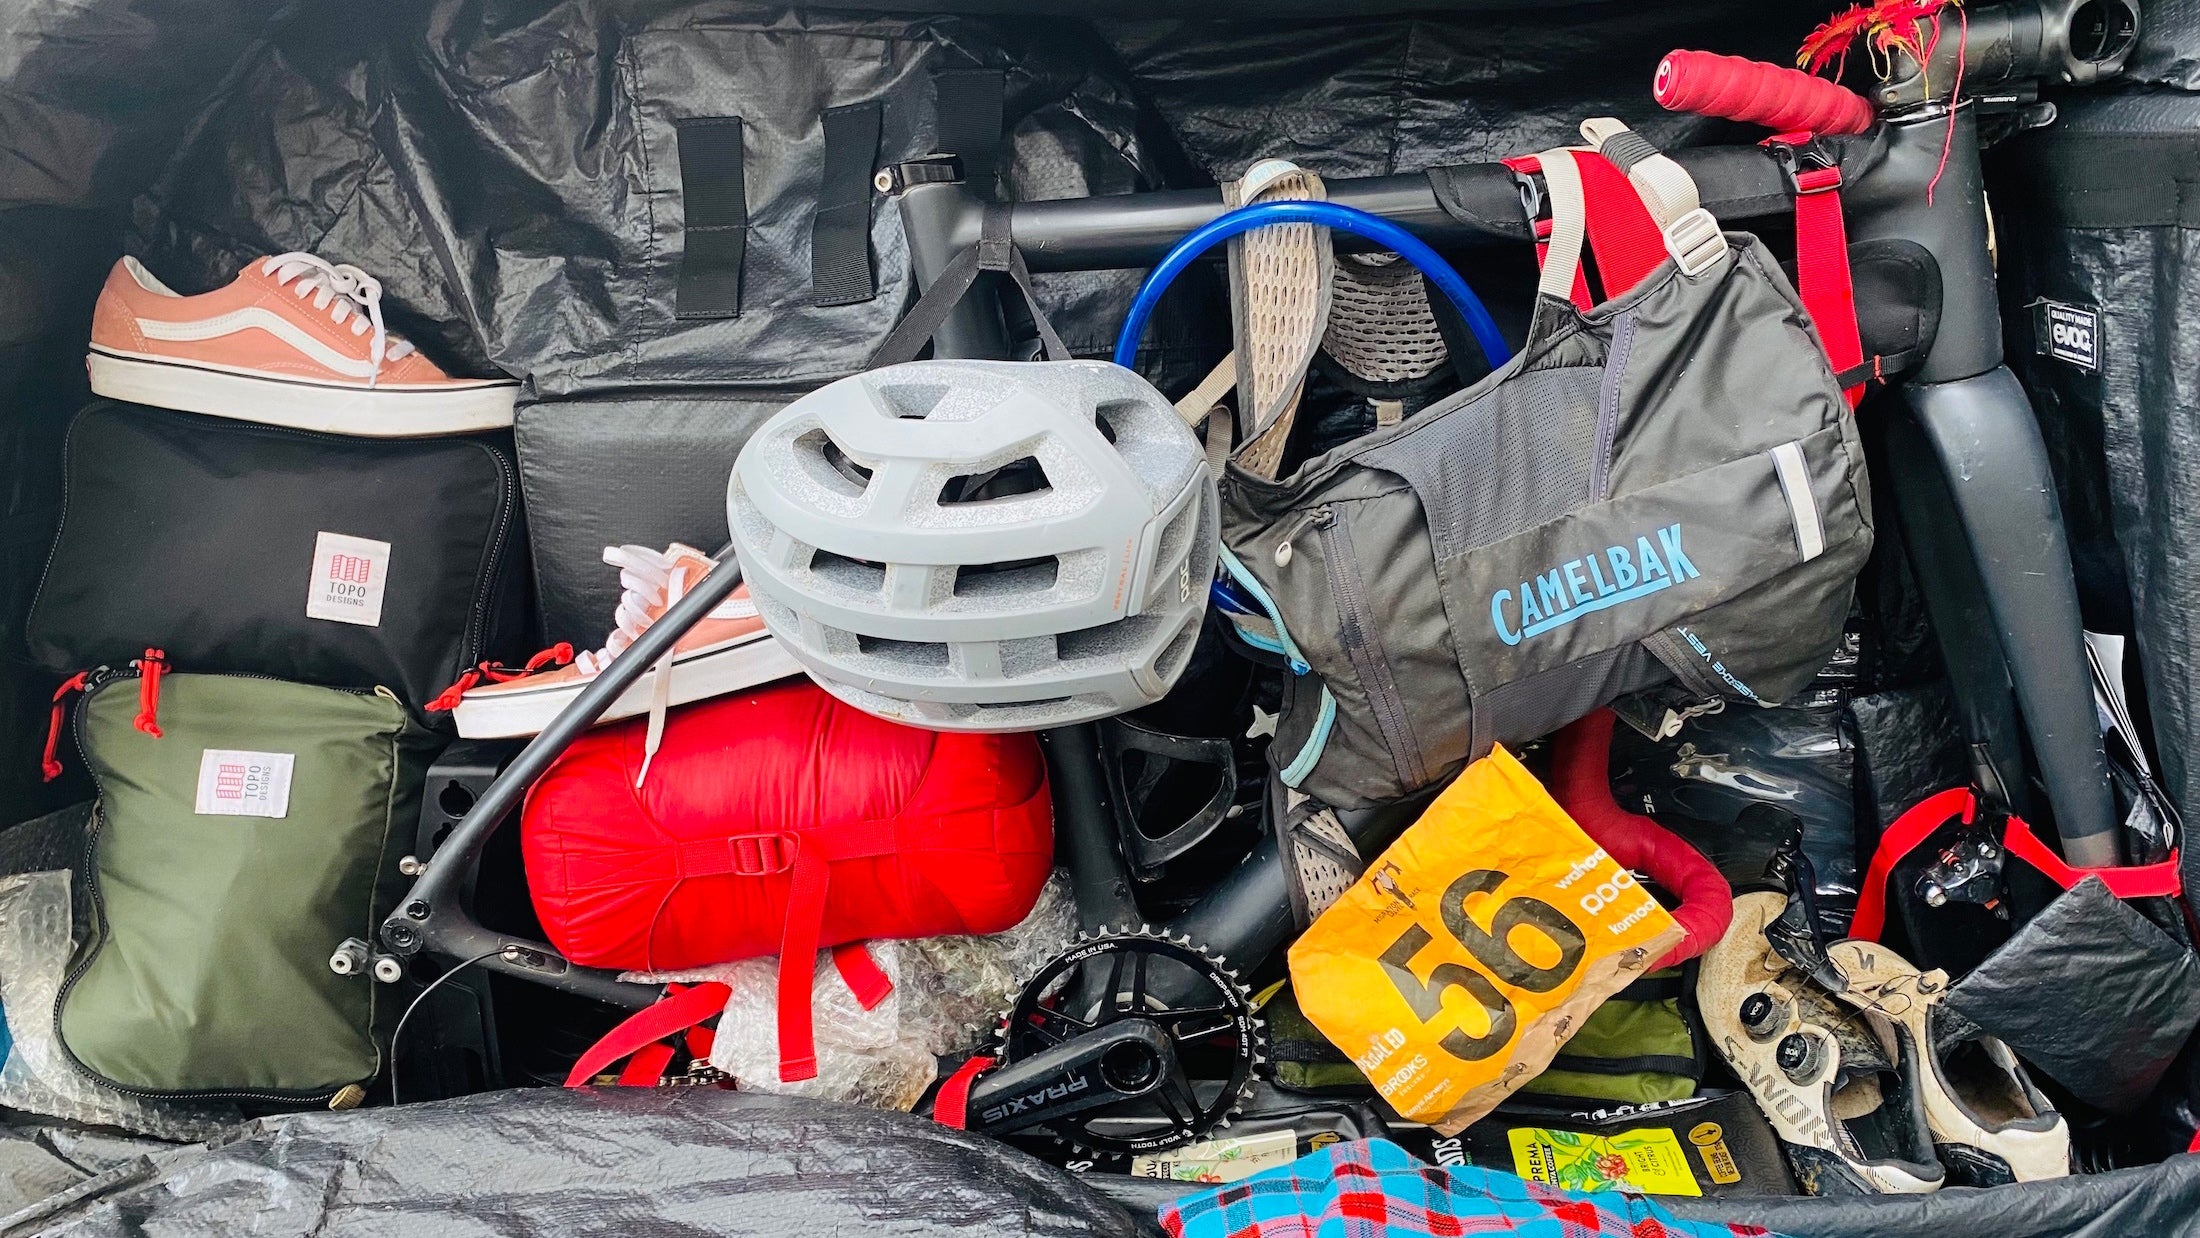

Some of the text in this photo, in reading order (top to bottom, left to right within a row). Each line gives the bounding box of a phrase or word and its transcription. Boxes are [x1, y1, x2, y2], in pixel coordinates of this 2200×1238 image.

[2051, 309, 2075, 323] QUALITY
[326, 594, 365, 607] DESIGNS
[329, 581, 366, 598] TOPO
[1490, 523, 1701, 646] CAMELBAK
[1676, 627, 1712, 662] VEST
[244, 765, 262, 799] TOPO
[258, 765, 272, 801] DESIGNS
[1607, 896, 1658, 936] komoo
[1065, 949, 1088, 964] MADE
[1087, 945, 1097, 954] IN
[1376, 869, 1587, 1062] 56
[1380, 1053, 1428, 1097] BROOKS
[982, 1075, 1089, 1124] PRAXIS
[1131, 1134, 1181, 1149] WOLF TOOTH
[1643, 1146, 1660, 1168] CITRUS
[1633, 1151, 1651, 1172] BRIGHT
